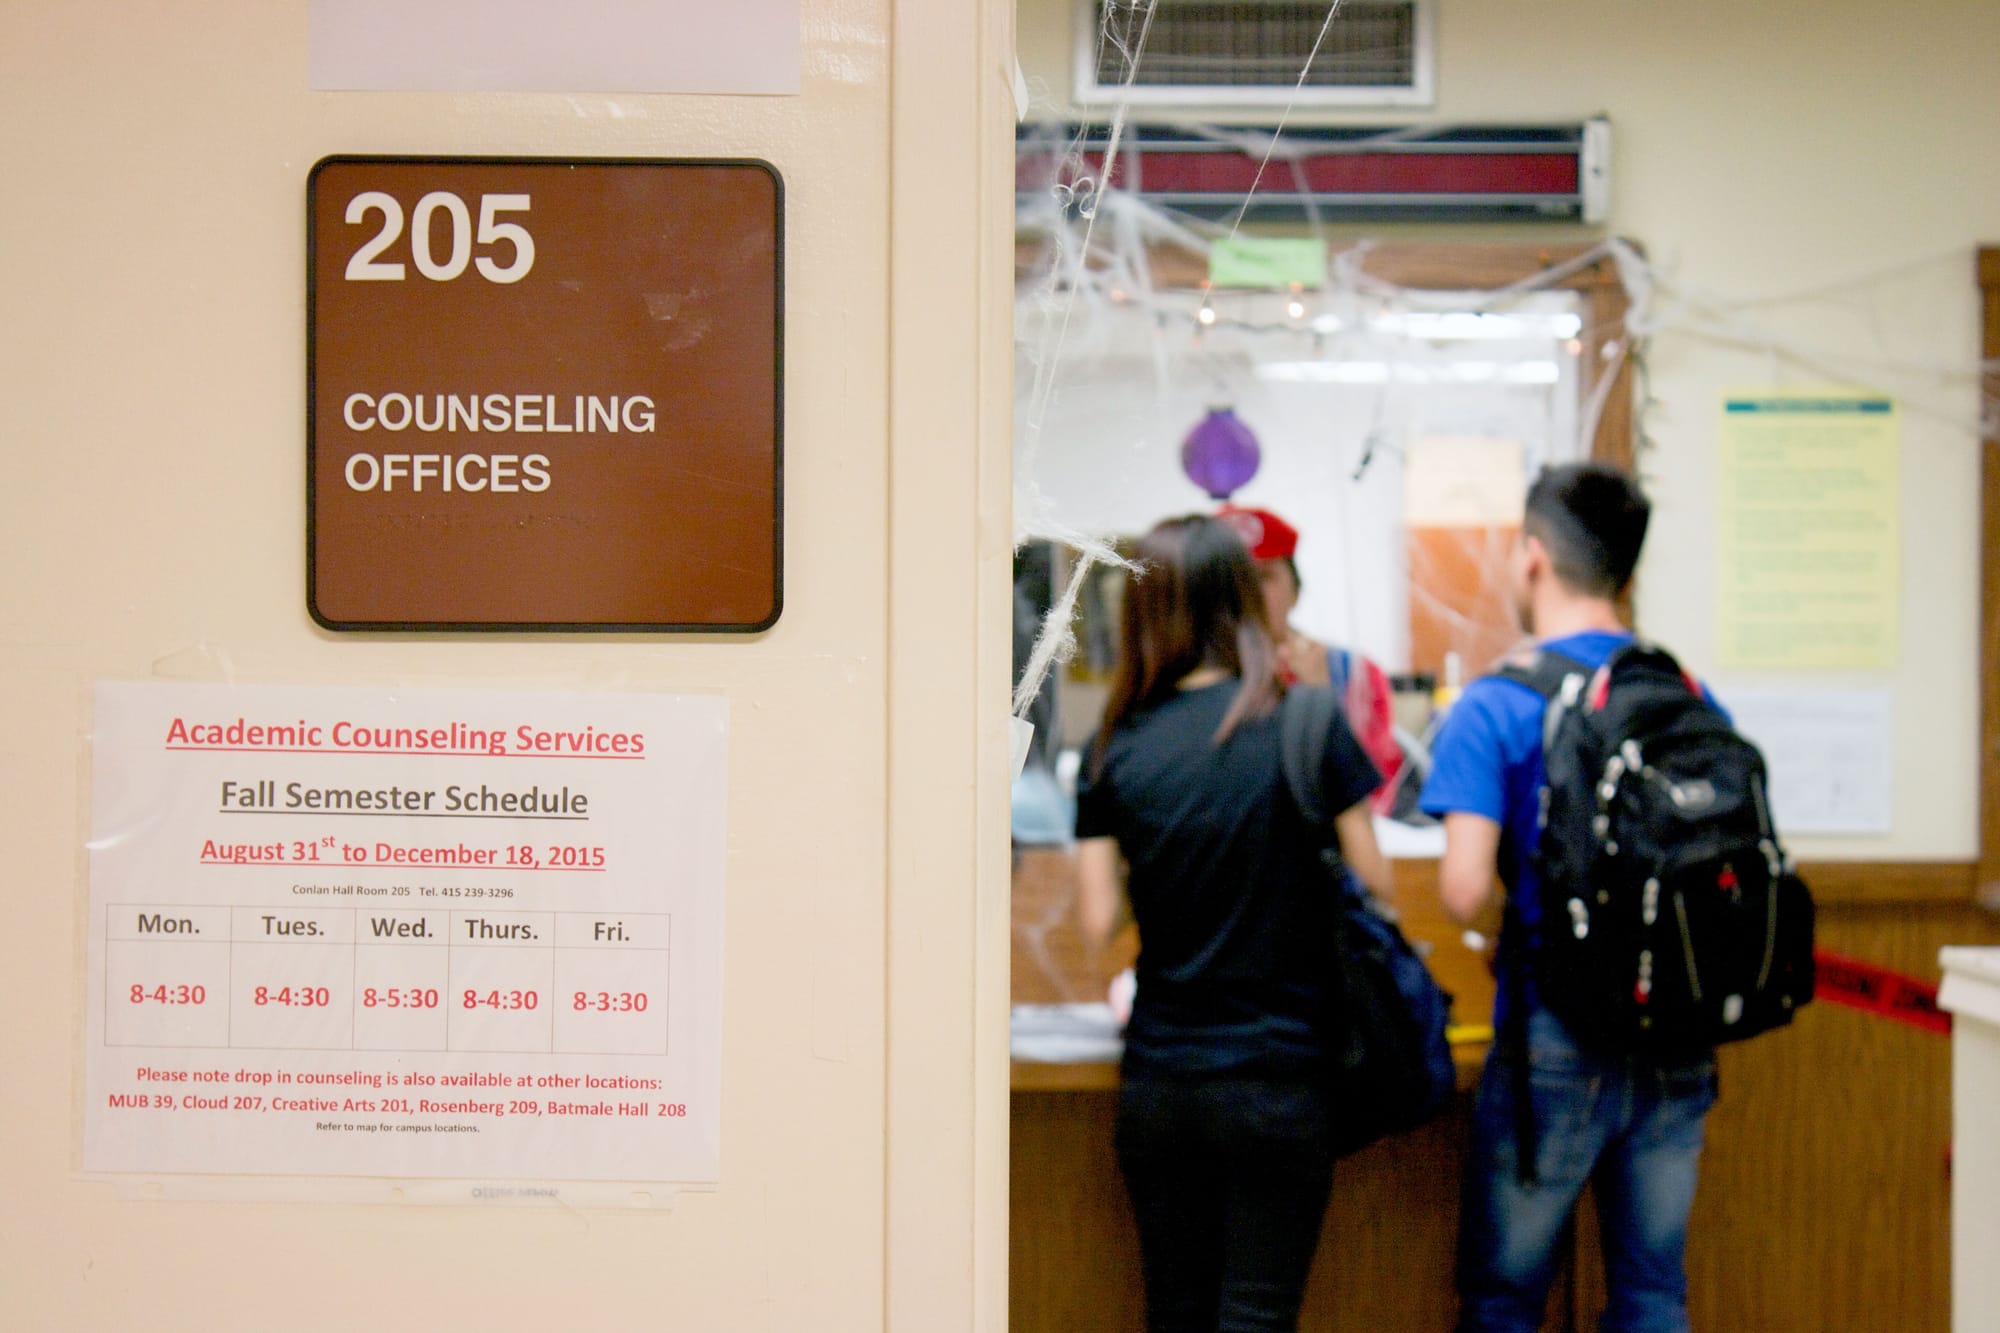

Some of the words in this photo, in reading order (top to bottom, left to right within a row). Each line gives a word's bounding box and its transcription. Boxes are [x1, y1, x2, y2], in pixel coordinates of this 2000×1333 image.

[344, 191, 535, 284] 205
[343, 392, 655, 433] COUNSELING
[344, 453, 551, 492] OFFICES
[166, 718, 323, 748] Academic
[332, 721, 507, 755] Counseling
[515, 725, 645, 754] Services
[221, 780, 275, 809] Fall
[286, 782, 435, 812] Semester
[444, 784, 589, 815] Schedule
[200, 839, 285, 865] August
[292, 836, 335, 861] 31st
[341, 844, 367, 863] to
[375, 843, 498, 866] December
[505, 845, 541, 869] 18,
[548, 846, 606, 868] 2015
[292, 884, 330, 896] Conlan
[332, 884, 354, 896] Hall
[356, 886, 389, 897] Room
[391, 886, 411, 897] 205
[419, 886, 439, 897] Tel.
[441, 887, 461, 898] 415
[464, 888, 514, 899] 239-3296
[137, 913, 200, 935] Mon.
[261, 914, 324, 937] Tues.
[371, 916, 434, 939] Wed.
[465, 917, 539, 941] Thurs.
[594, 921, 631, 943] Fri.
[129, 984, 206, 1005] 8-4:30
[253, 986, 330, 1007] 8-4:30
[363, 987, 439, 1009] 8-5:30
[463, 990, 539, 1011] 8-4:30
[572, 991, 648, 1012] 8-3:30
[136, 1067, 188, 1085] Please
[192, 1070, 230, 1085] note
[234, 1069, 273, 1088] drop
[277, 1069, 292, 1085] in
[296, 1069, 382, 1088] counseling
[386, 1071, 399, 1087] is
[403, 1071, 435, 1088] also
[439, 1071, 512, 1088] available
[516, 1074, 532, 1088] at
[536, 1074, 581, 1089] other
[585, 1074, 663, 1090] locations:
[108, 1094, 149, 1111] MUB
[153, 1095, 178, 1113] 39,
[182, 1096, 229, 1112] Cloud
[232, 1096, 267, 1113] 207,
[272, 1097, 339, 1113] Creative
[342, 1098, 376, 1113] Arts
[380, 1099, 415, 1116] 201,
[420, 1099, 504, 1119] Rosenberg
[508, 1100, 543, 1119] 209,
[548, 1101, 614, 1117] Batmale
[618, 1101, 648, 1117] Hall
[658, 1102, 687, 1118] 208
[315, 1121, 341, 1133] Refer
[343, 1123, 354, 1134] to
[356, 1123, 377, 1135] map
[379, 1122, 394, 1134] for
[396, 1123, 431, 1136] campus
[434, 1122, 480, 1135] locations.
